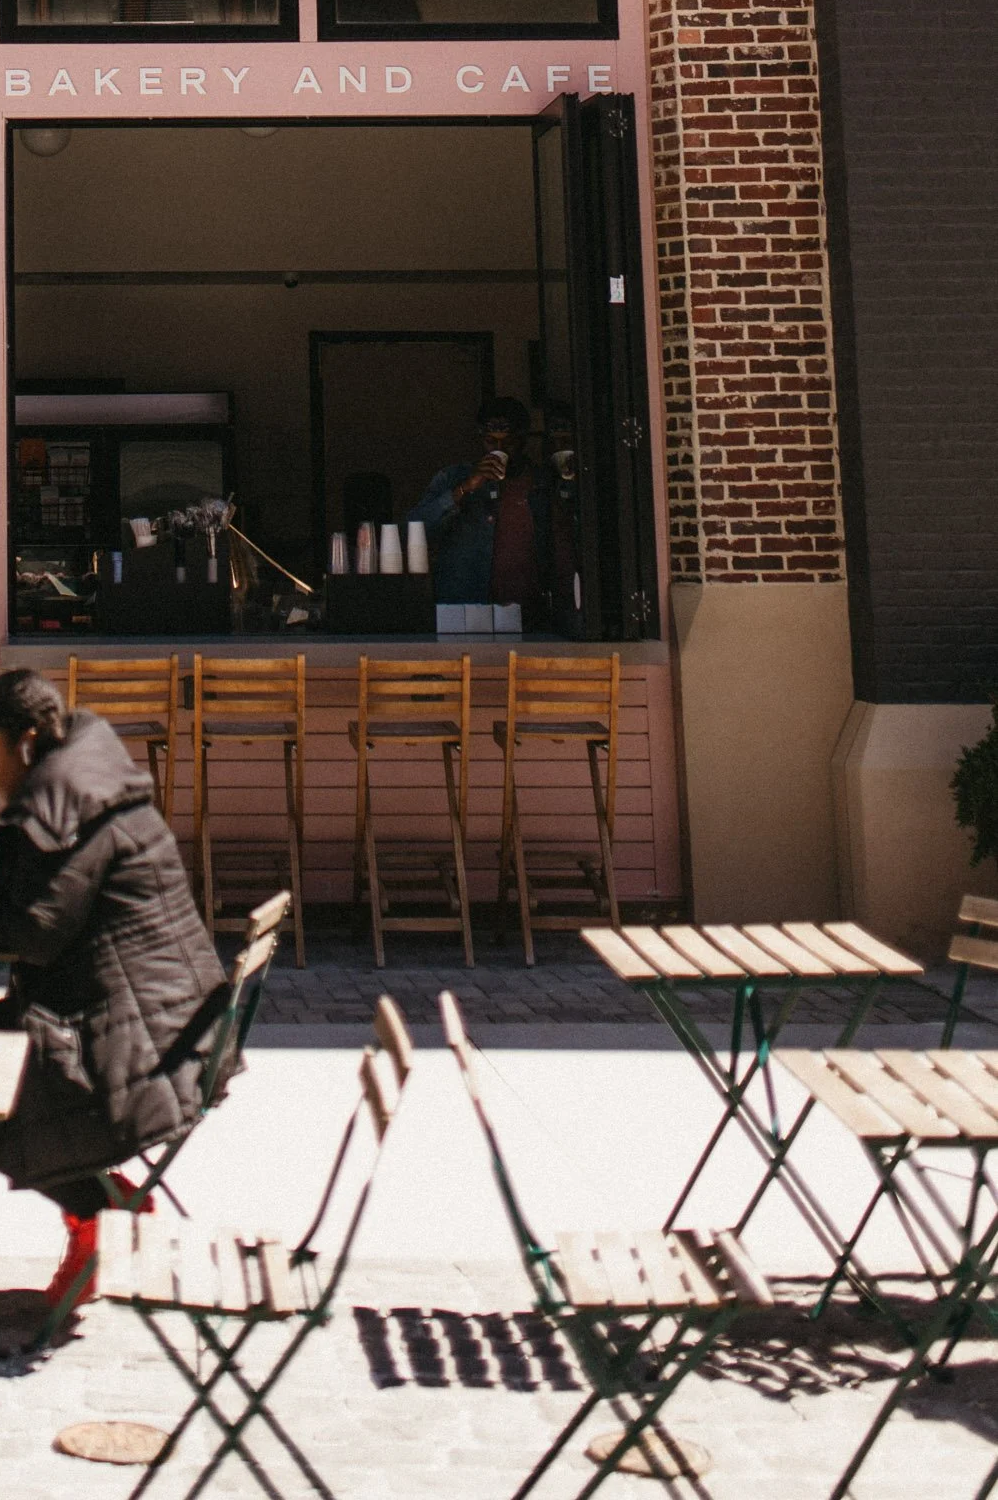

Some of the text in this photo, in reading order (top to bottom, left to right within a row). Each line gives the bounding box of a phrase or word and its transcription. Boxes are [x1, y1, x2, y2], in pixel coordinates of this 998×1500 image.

[5, 64, 614, 97] BAKERY AND CAFE
